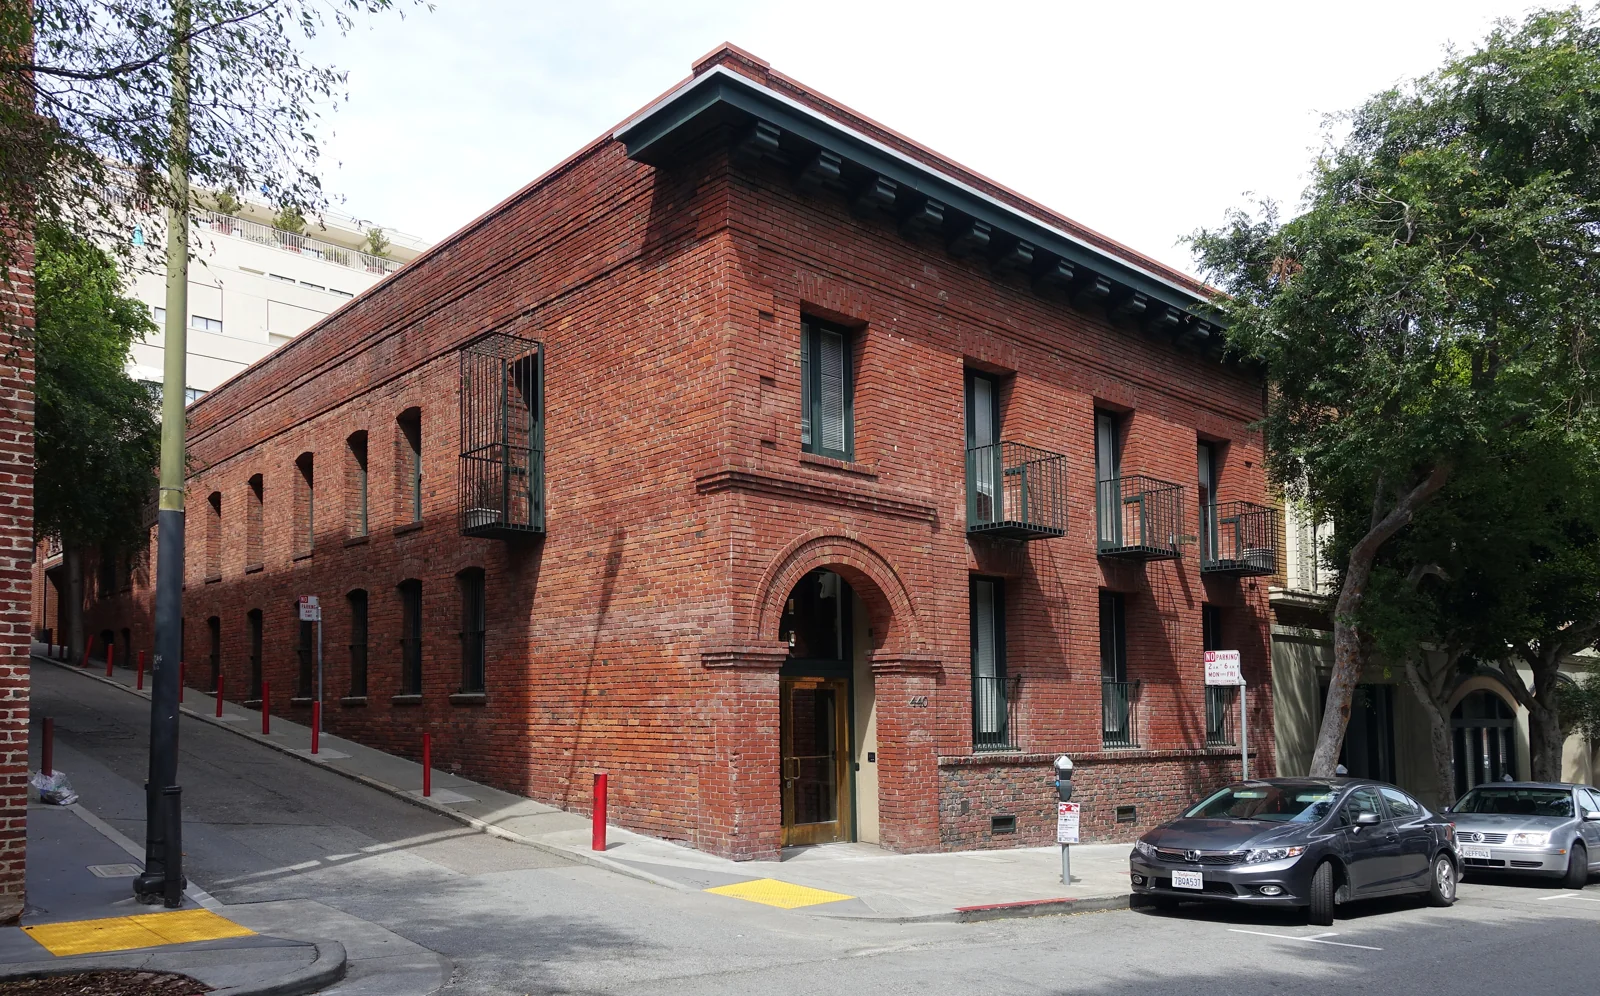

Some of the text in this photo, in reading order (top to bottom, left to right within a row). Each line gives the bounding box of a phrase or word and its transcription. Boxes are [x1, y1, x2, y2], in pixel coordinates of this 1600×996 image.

[1205, 652, 1238, 662] NO PARKING
[910, 695, 928, 708] 440
